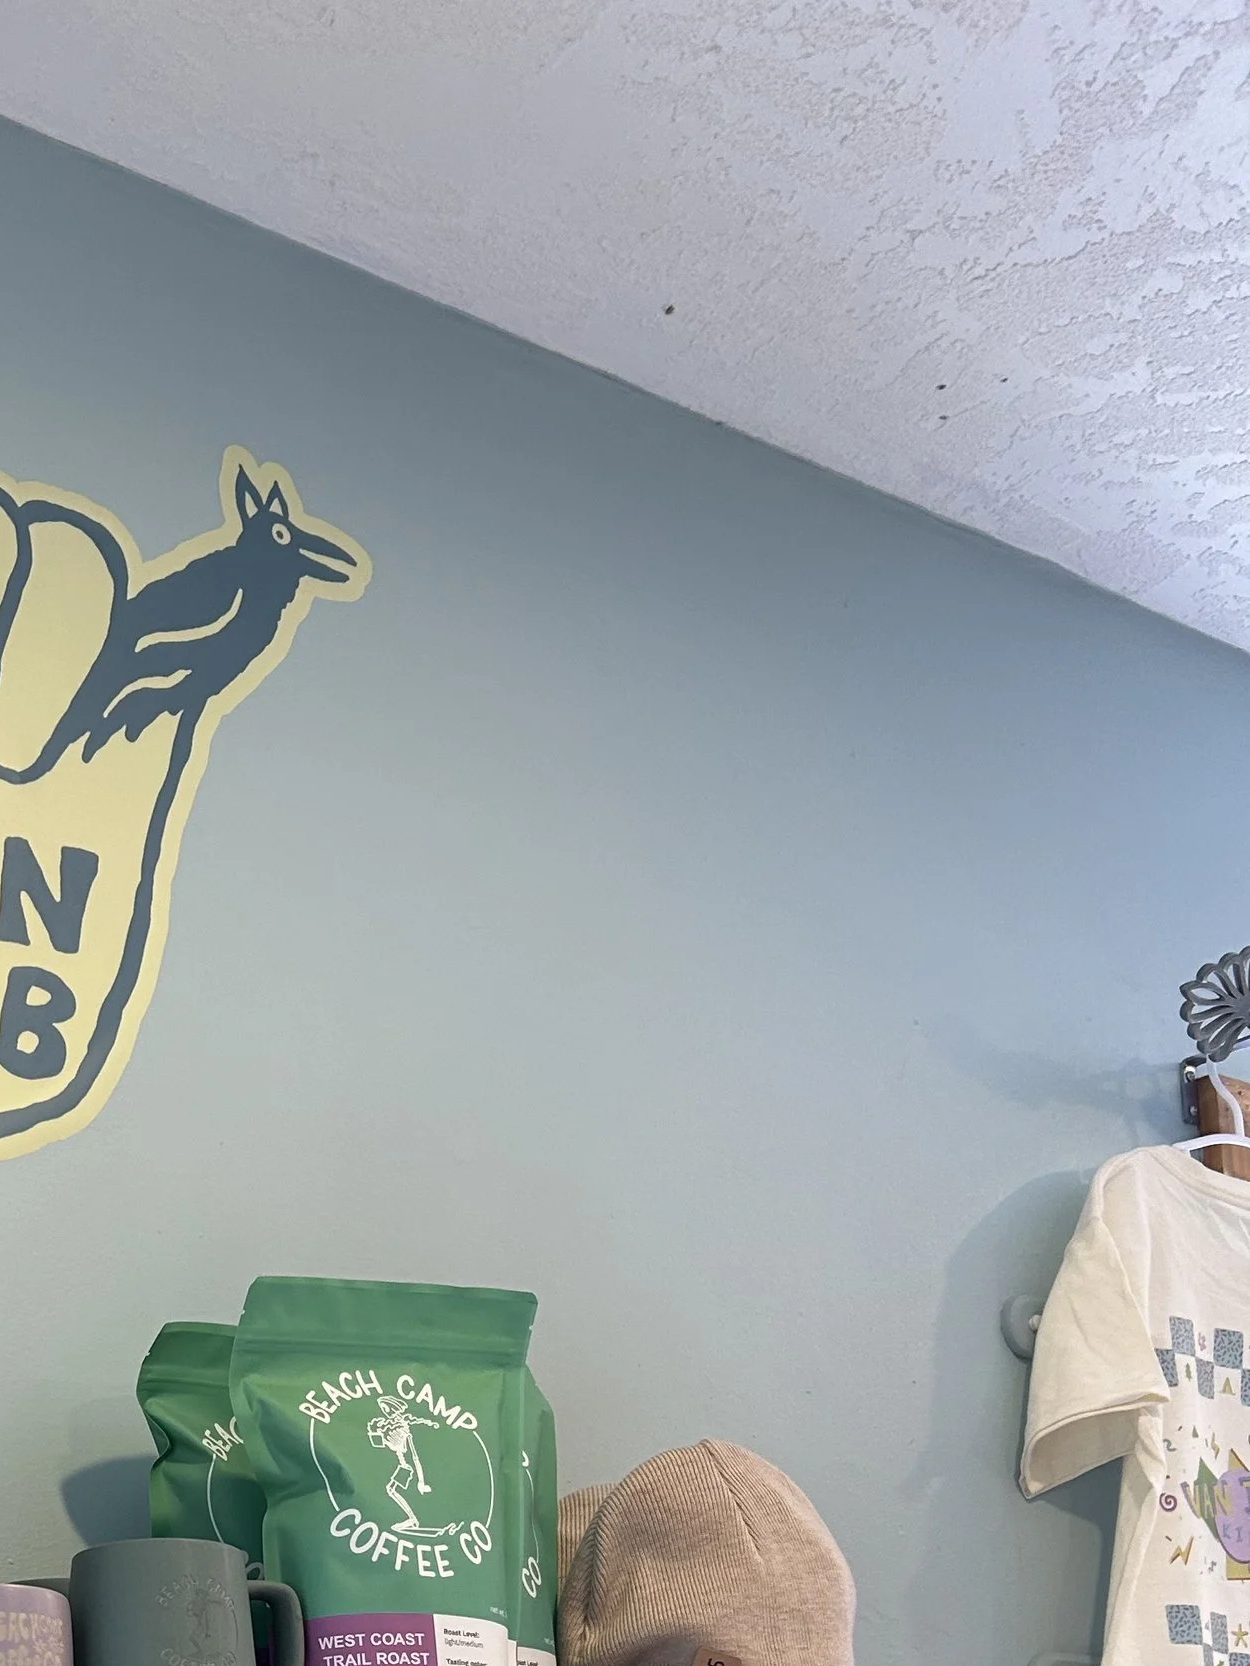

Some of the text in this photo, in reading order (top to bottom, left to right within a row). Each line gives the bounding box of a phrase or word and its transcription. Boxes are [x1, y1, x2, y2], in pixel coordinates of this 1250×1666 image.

[299, 1370, 478, 1430] BEACH CAMP
[330, 1508, 492, 1578] COFFEE CO
[318, 1632, 425, 1650] WEST COAST
[376, 1652, 430, 1666] ROAST
